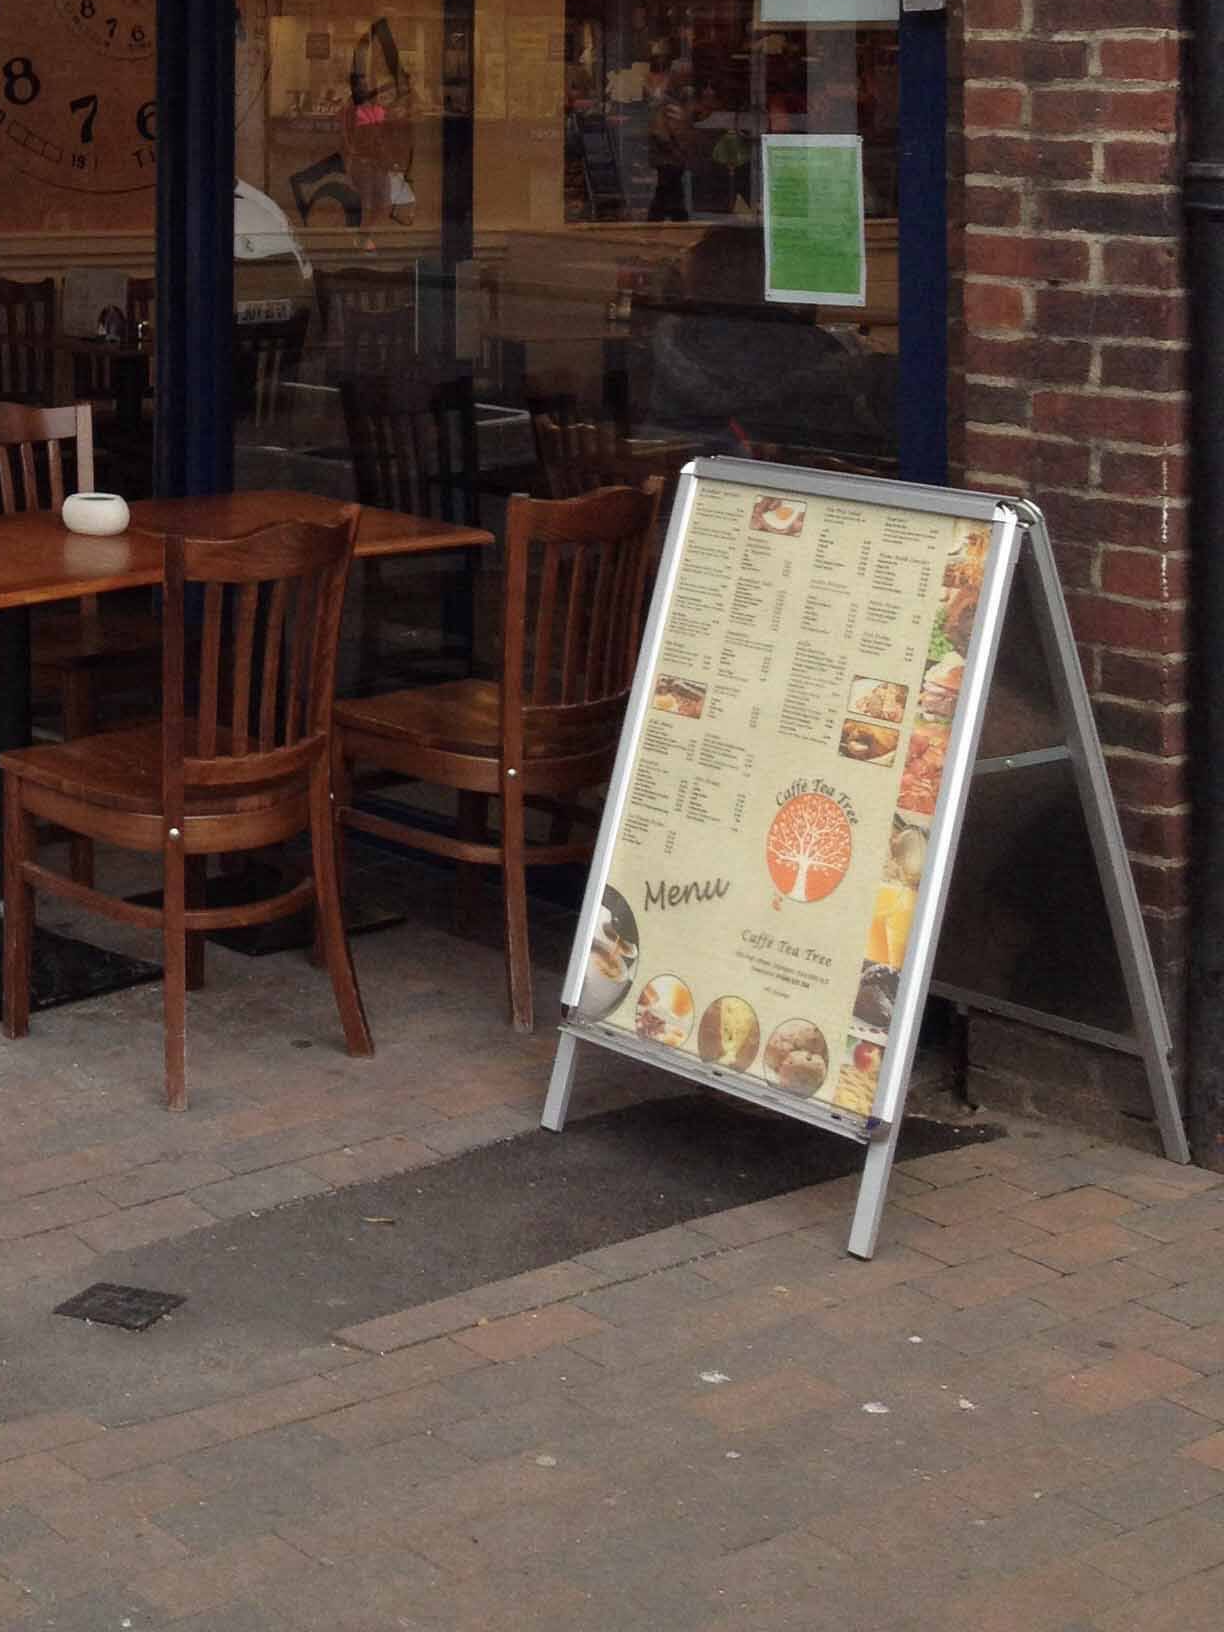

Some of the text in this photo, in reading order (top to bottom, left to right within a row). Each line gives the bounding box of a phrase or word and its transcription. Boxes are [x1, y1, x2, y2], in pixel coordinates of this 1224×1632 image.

[3, 57, 41, 106] 8
[69, 94, 99, 145] 7
[643, 878, 730, 913] Menu
